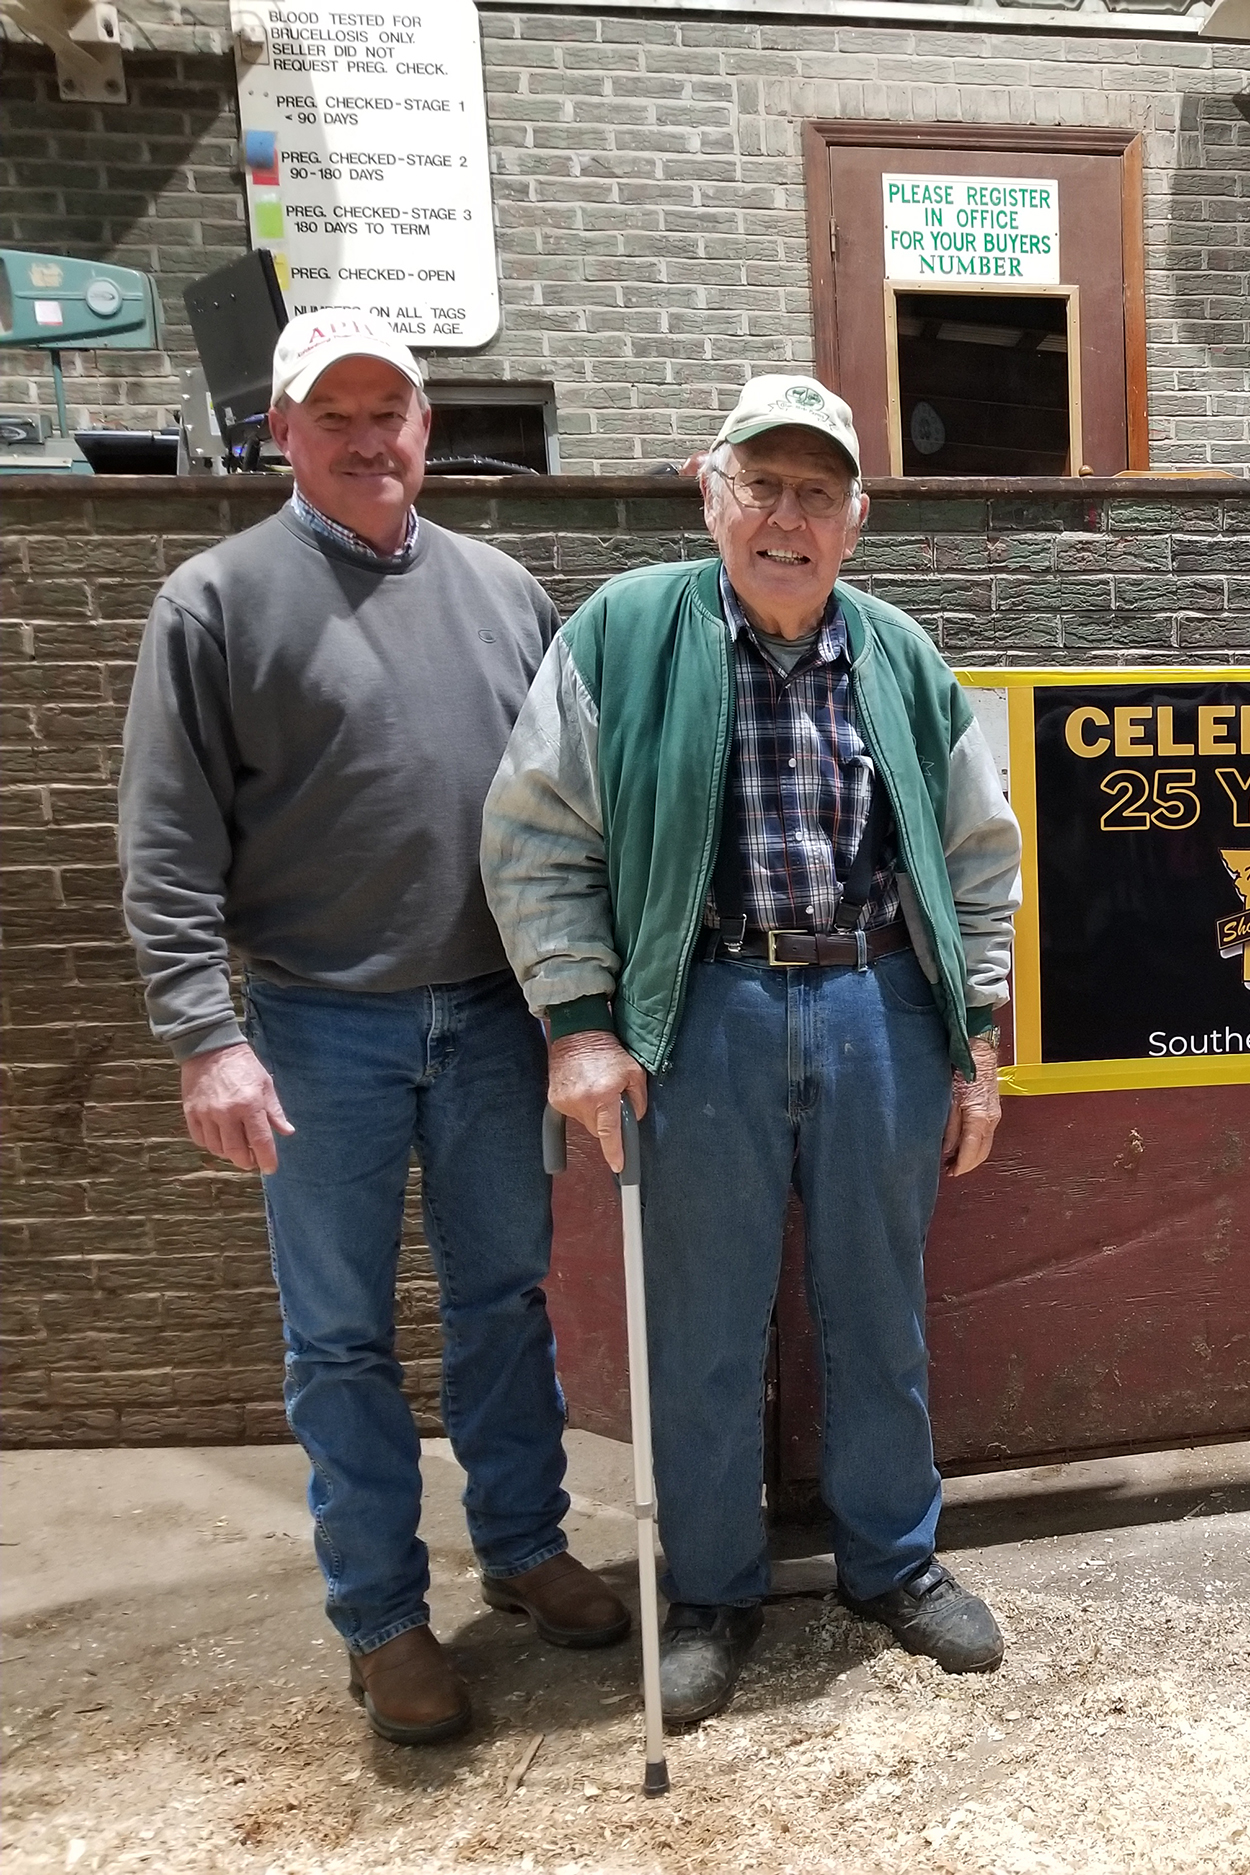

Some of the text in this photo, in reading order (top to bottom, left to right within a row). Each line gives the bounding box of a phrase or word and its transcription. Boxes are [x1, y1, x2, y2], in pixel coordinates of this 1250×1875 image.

[269, 11, 422, 28] BLOOD TESTED FOR
[270, 28, 415, 44] BRUCELLOSIS ONLY.
[272, 44, 395, 59] SELLER DID NOT
[273, 59, 448, 76] REQUEST PREG. CHECK.
[276, 95, 318, 108] PREG.
[458, 101, 465, 112] 1
[297, 112, 317, 125] 90
[324, 113, 359, 126] DAYS
[281, 151, 322, 164] PREG.
[459, 156, 468, 168] 2
[290, 167, 384, 181] 90-180 DAYS
[888, 183, 1051, 208] PLEASE REGISTER
[285, 205, 327, 218] PREG.
[463, 209, 472, 221] 3
[925, 208, 1019, 230] IN OFFICE
[295, 221, 430, 236] 180 DAYS TO TERM
[891, 230, 1051, 254] FOR YOUR BUYERS
[290, 267, 331, 280] PREG.
[918, 255, 1023, 277] NUMBER
[370, 306, 390, 318] ON
[396, 307, 422, 319] ALL
[430, 307, 466, 320] TAGS
[433, 323, 463, 335] AGE.
[1100, 768, 1200, 831] 25
